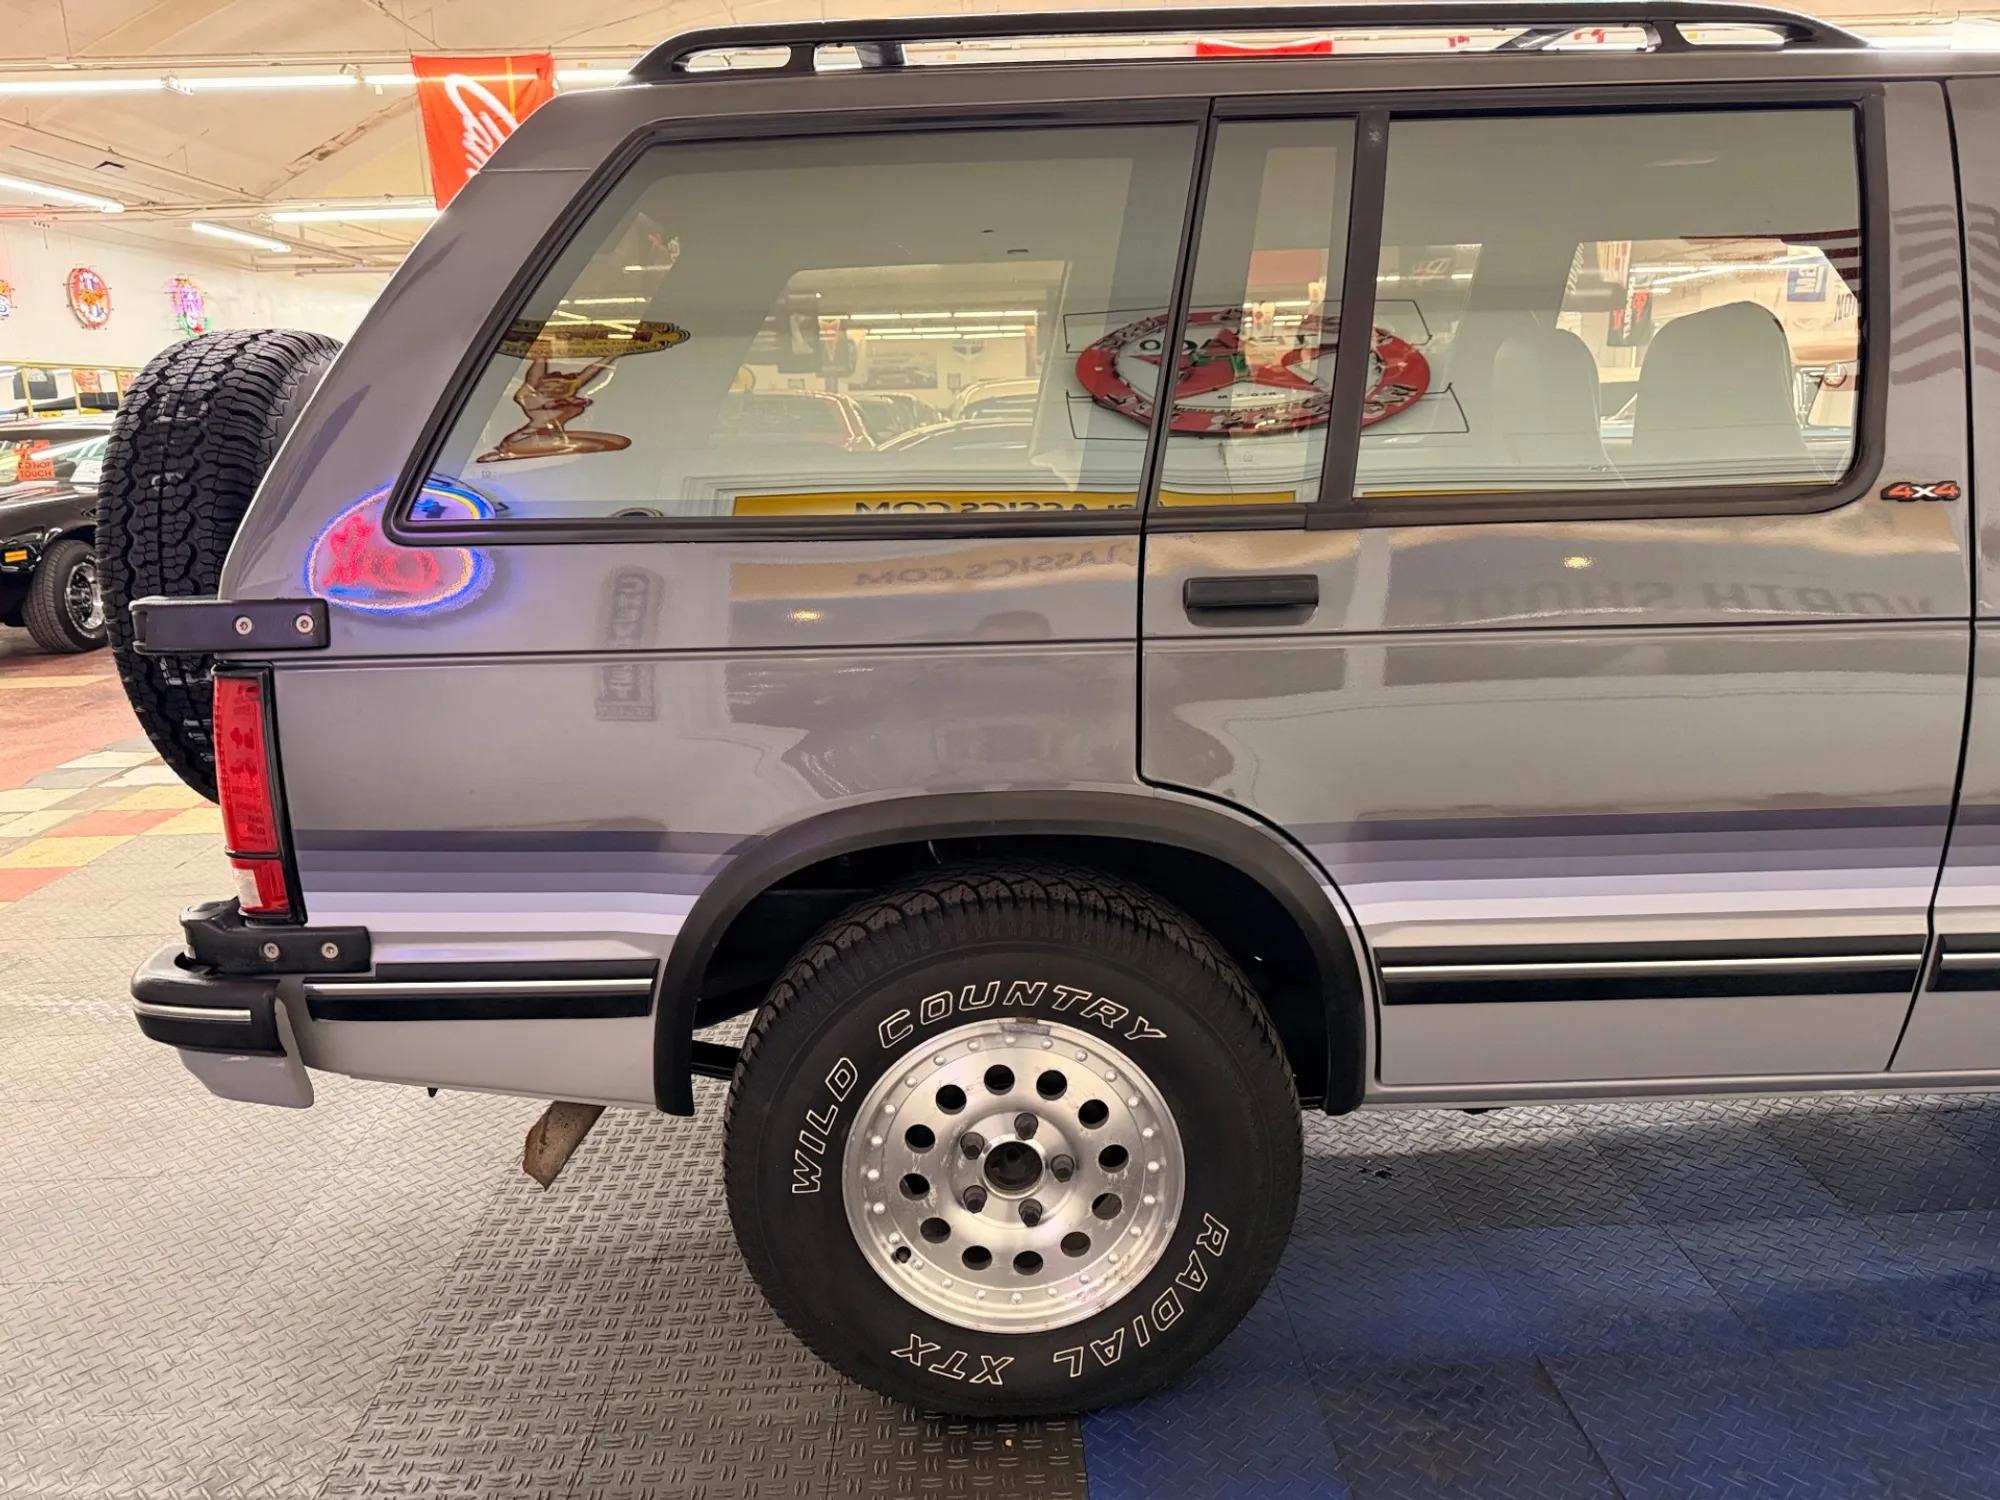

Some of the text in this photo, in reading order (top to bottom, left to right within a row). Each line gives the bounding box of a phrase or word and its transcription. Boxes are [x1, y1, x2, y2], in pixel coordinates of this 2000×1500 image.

[791, 979, 1168, 1195] WILD COUNTRY
[891, 1212, 1230, 1386] RADIAL XTX
